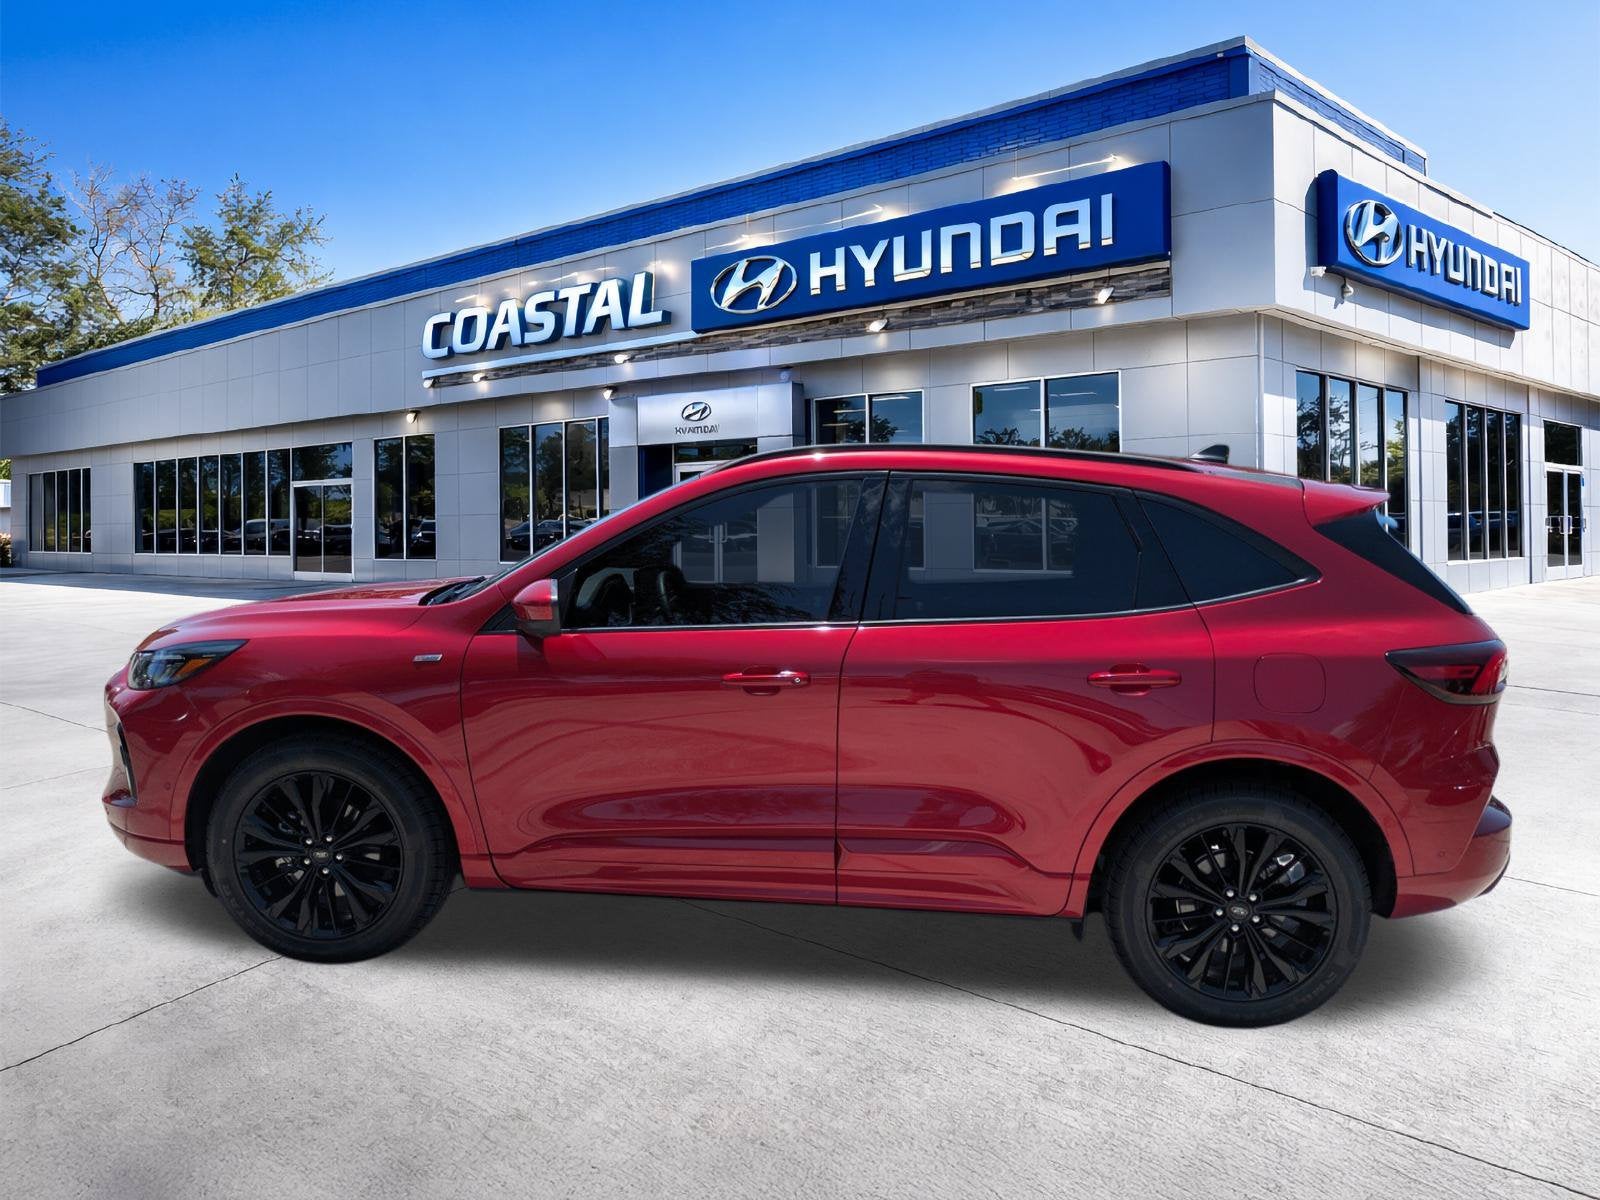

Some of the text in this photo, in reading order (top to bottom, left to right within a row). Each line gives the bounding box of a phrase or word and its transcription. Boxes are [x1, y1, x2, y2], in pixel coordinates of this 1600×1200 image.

[810, 193, 1113, 295] HYUNDAI
[1406, 224, 1522, 307] HYUNDAI
[422, 272, 670, 359] COASTAL
